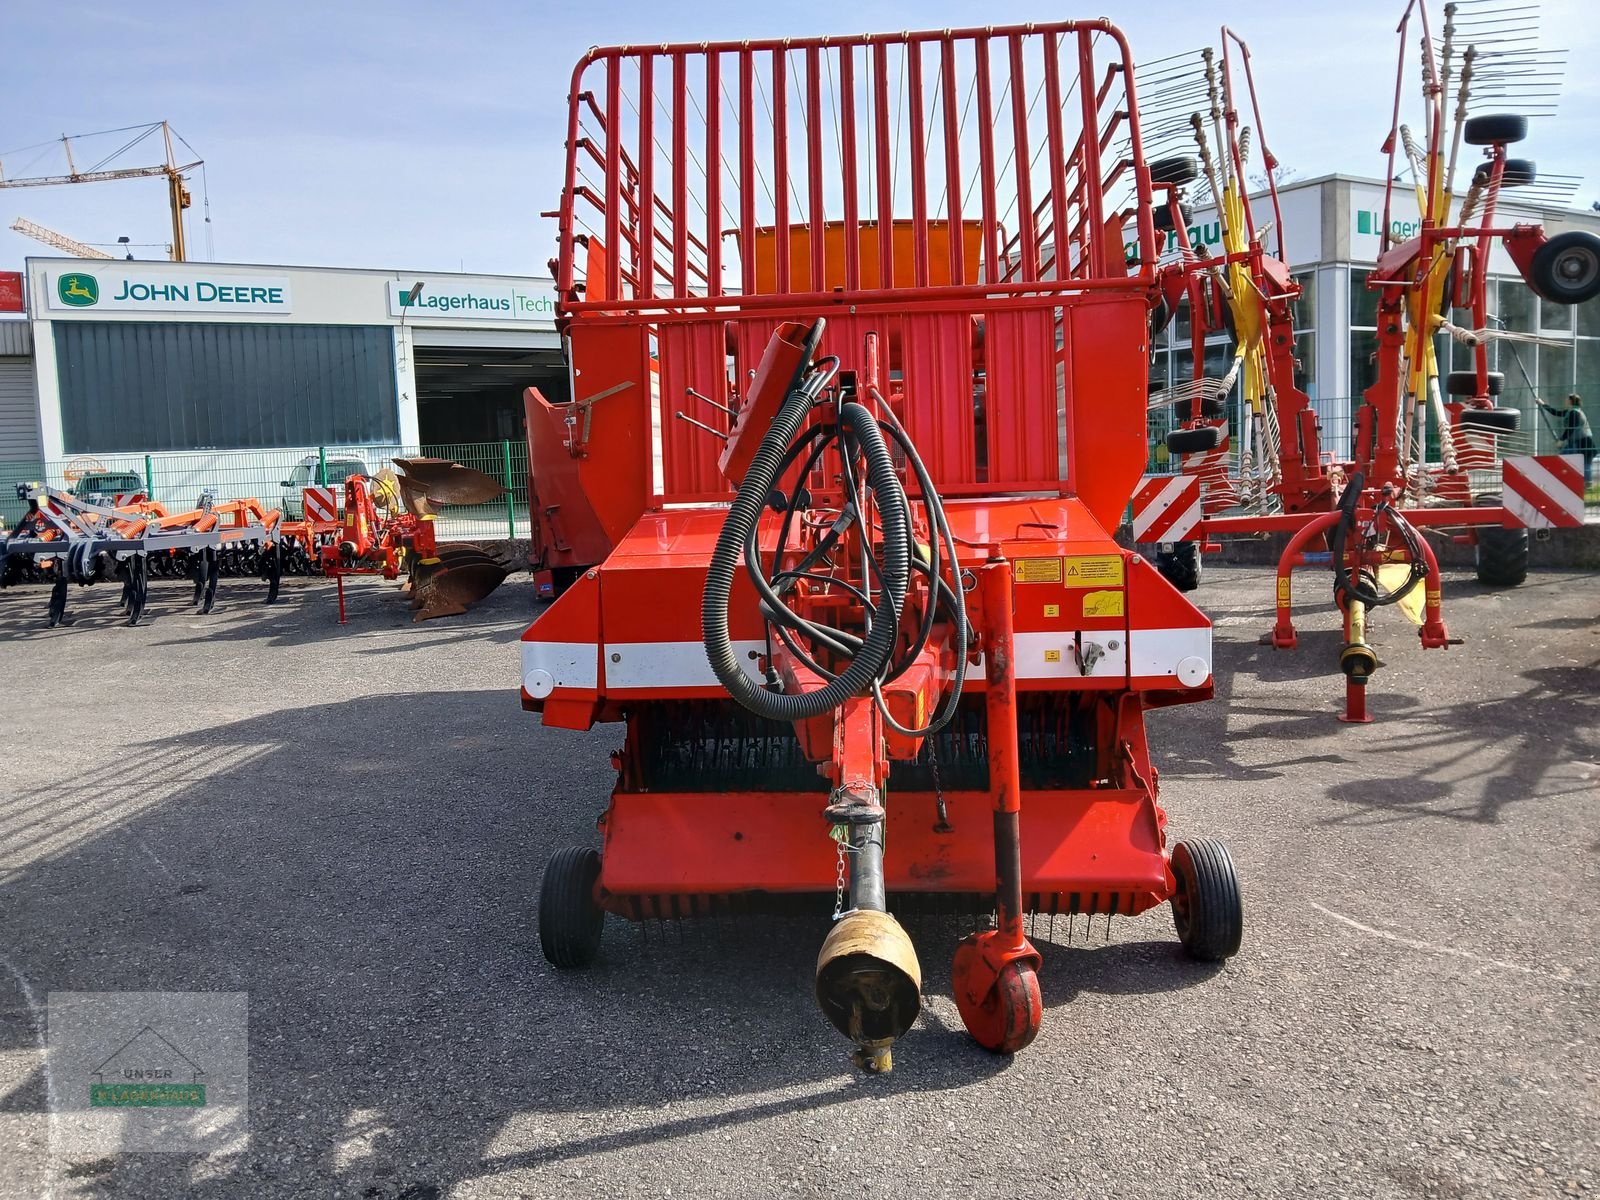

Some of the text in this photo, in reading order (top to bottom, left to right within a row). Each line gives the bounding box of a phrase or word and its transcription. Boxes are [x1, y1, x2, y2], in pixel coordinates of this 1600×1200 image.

[114, 280, 284, 304] JOHN DEERE
[418, 291, 510, 312] Lagerhaus
